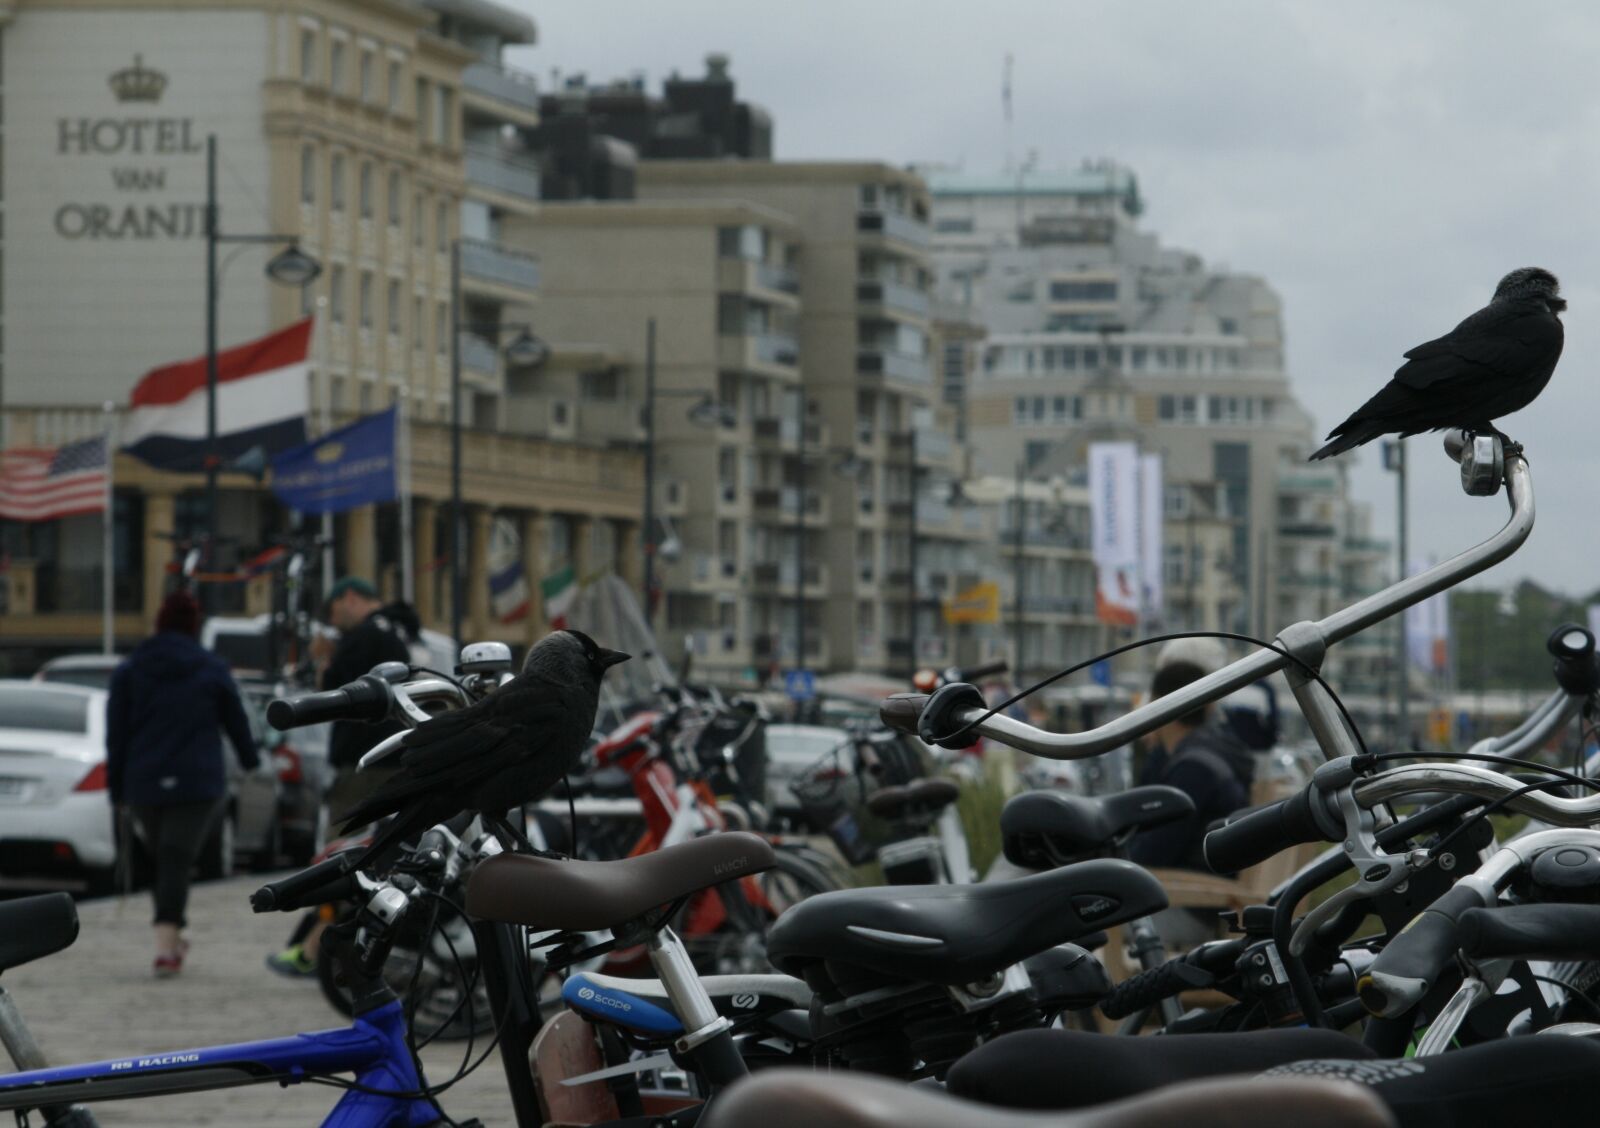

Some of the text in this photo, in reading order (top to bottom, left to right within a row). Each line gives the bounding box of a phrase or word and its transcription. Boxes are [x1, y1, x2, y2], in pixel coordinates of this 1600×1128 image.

[57, 118, 201, 154] HOTEL
[112, 168, 167, 190] VAN
[594, 993, 632, 1012] scope
[111, 1054, 199, 1071] RS RACING
